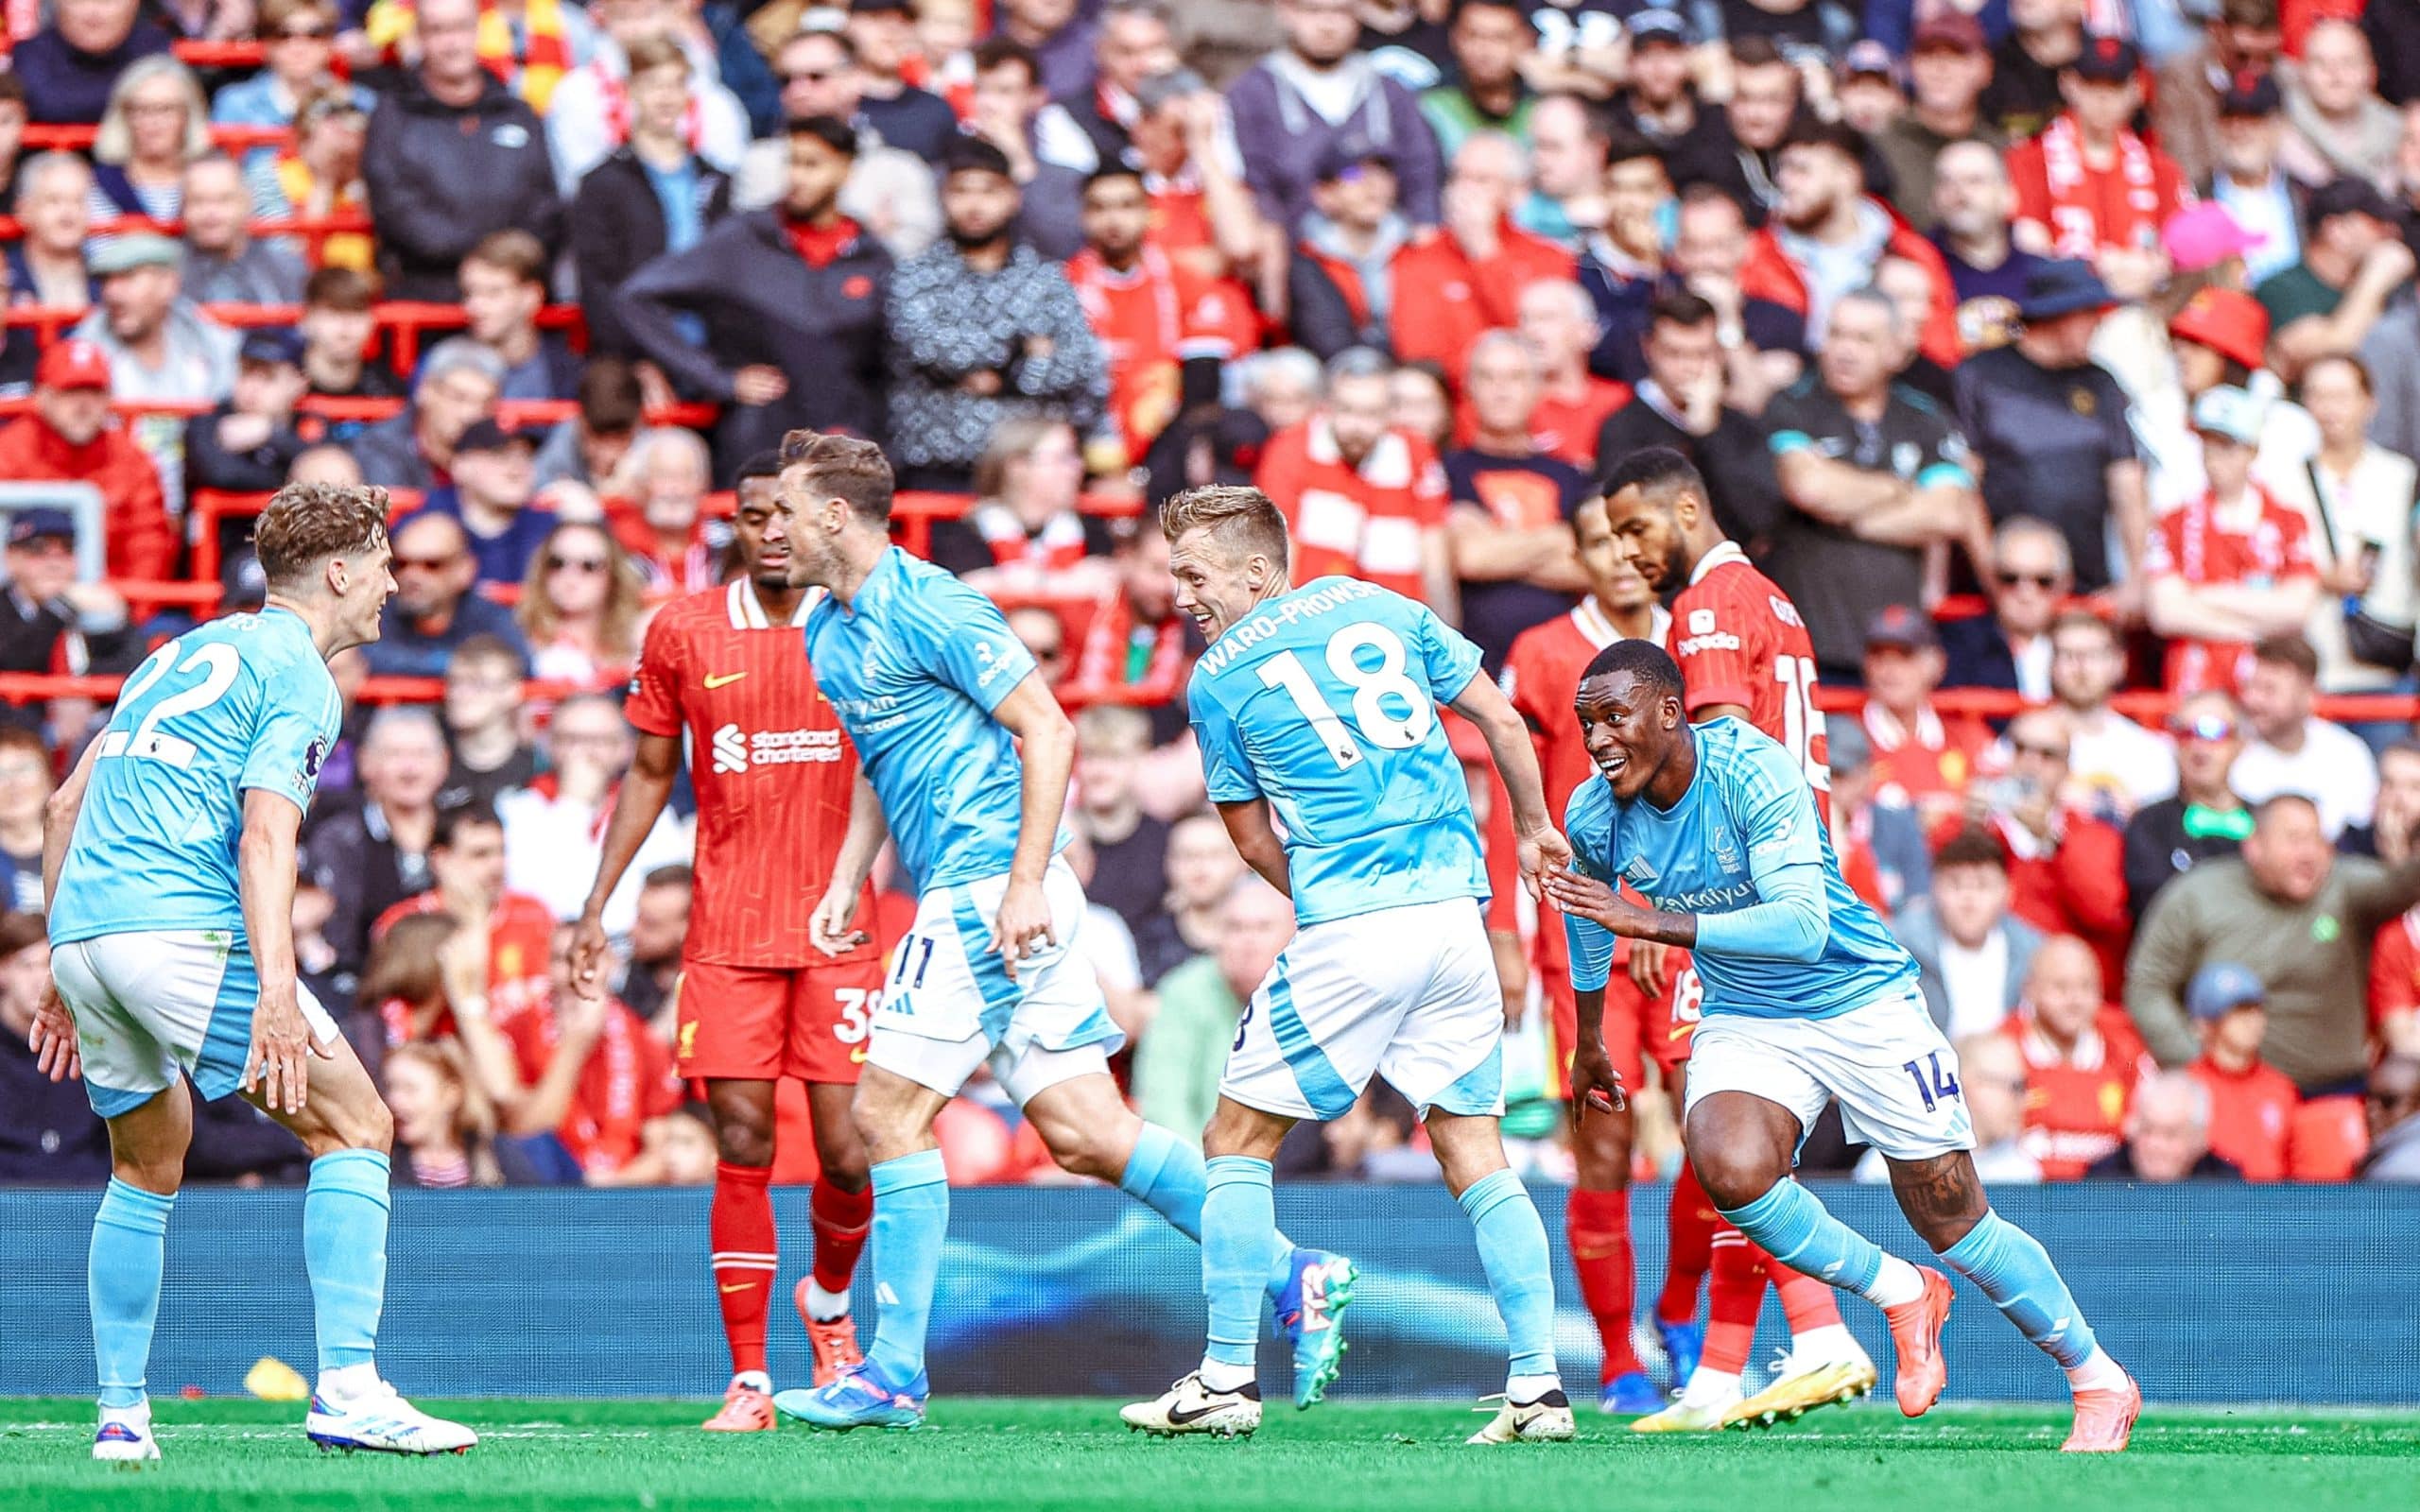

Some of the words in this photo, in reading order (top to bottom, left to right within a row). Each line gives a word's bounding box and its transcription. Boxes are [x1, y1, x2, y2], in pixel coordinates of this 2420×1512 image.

[95, 639, 246, 771] 22
[1254, 620, 1434, 772] 18
[751, 728, 840, 748] standard
[751, 745, 843, 765] chartered
[893, 934, 935, 989] 11
[1670, 967, 1704, 1023] 18
[1903, 1052, 1960, 1113] 14
